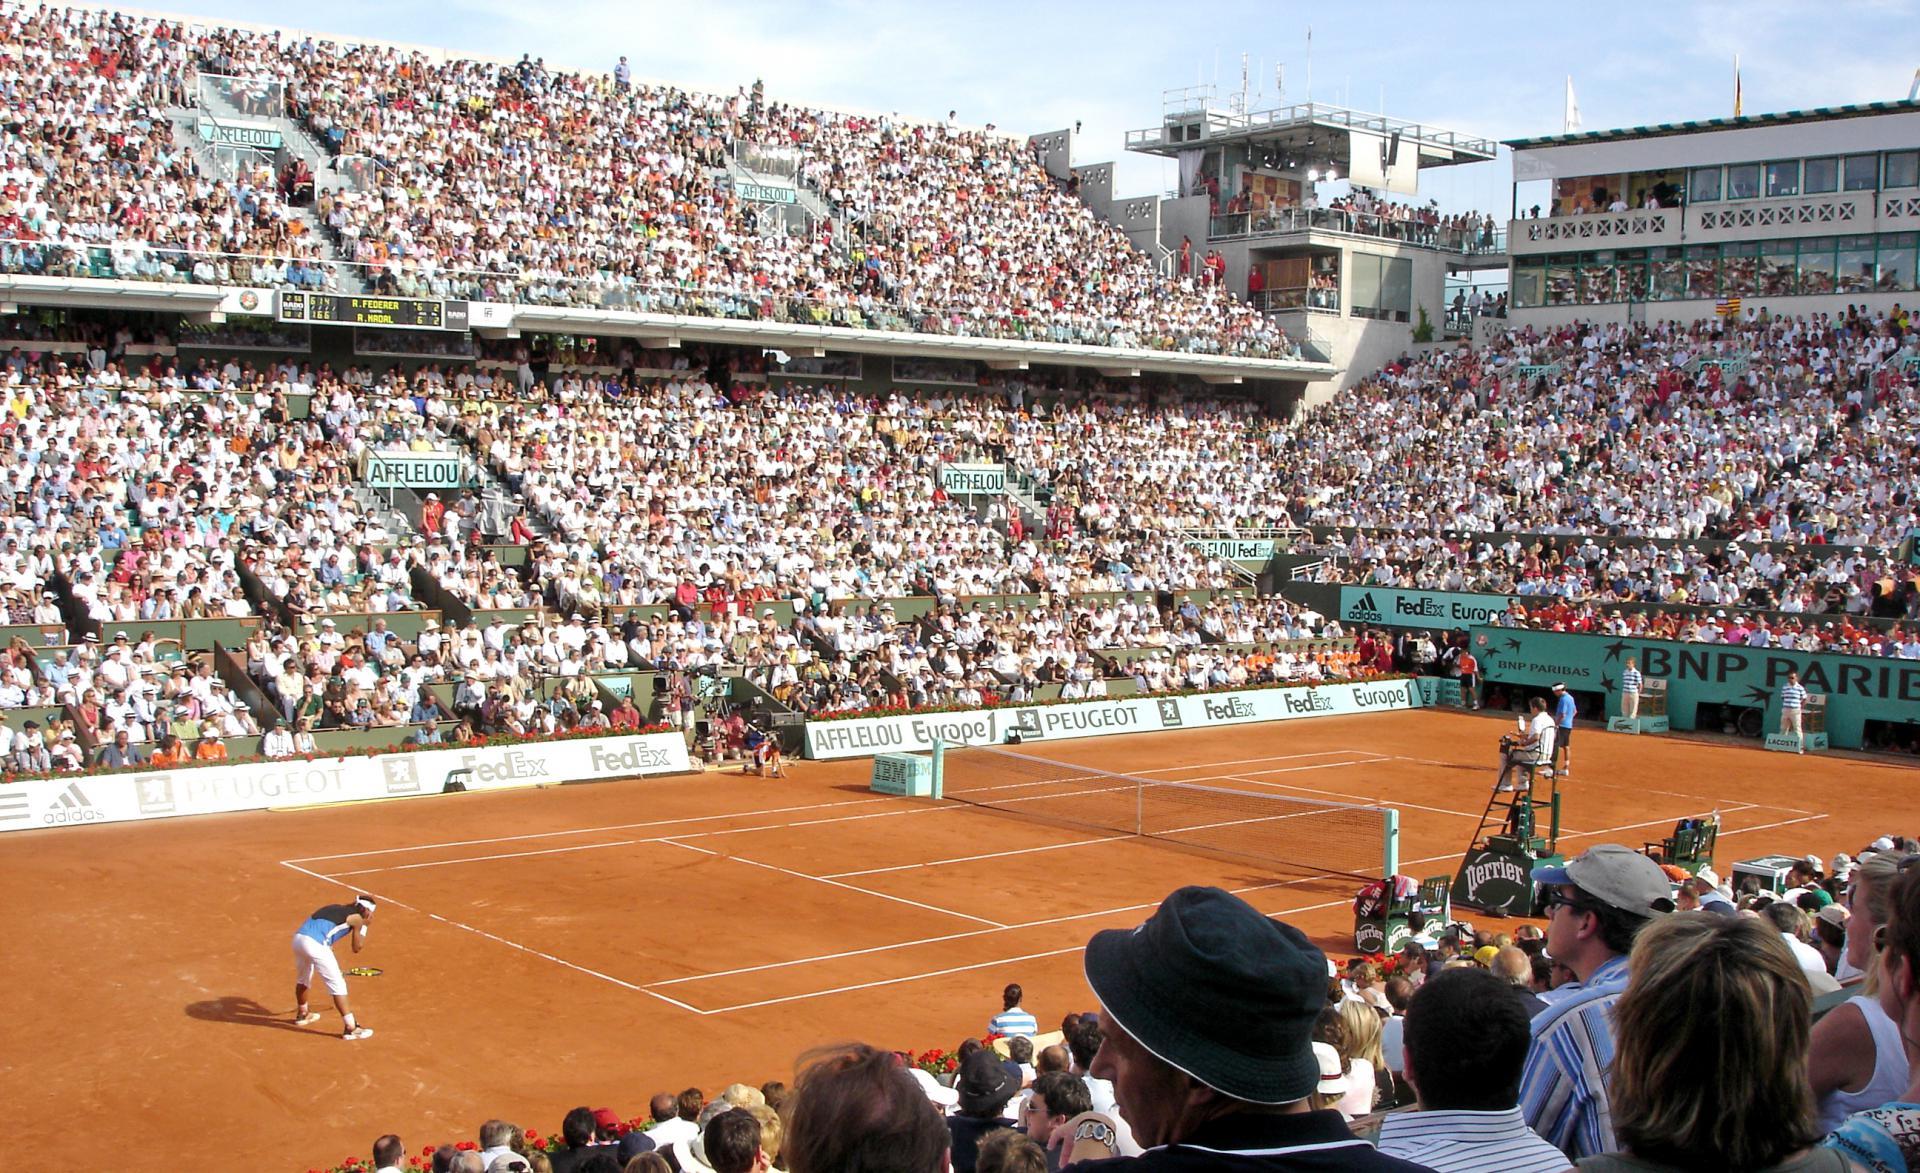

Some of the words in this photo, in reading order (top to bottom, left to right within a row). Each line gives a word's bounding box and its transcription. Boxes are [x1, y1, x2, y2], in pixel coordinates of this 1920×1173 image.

[371, 463, 458, 483] AFFLELOU
[944, 473, 1004, 490] AFFLELOU
[1348, 609, 1382, 622] adidas
[1396, 596, 1444, 617] FedEx
[1498, 660, 1526, 671] BNP
[1530, 663, 1590, 677] PARIBAS
[1641, 647, 1749, 683] BNP
[815, 723, 903, 751] AFFLELOU
[1046, 707, 1138, 731] PEUGEOT
[1203, 697, 1256, 720] FedEx
[1283, 690, 1334, 713] FedEx
[462, 752, 548, 783] FedEx
[590, 742, 671, 772] FedEx
[875, 759, 906, 784] IBM
[185, 768, 345, 801] PEUGEOT
[43, 807, 105, 824] adidas
